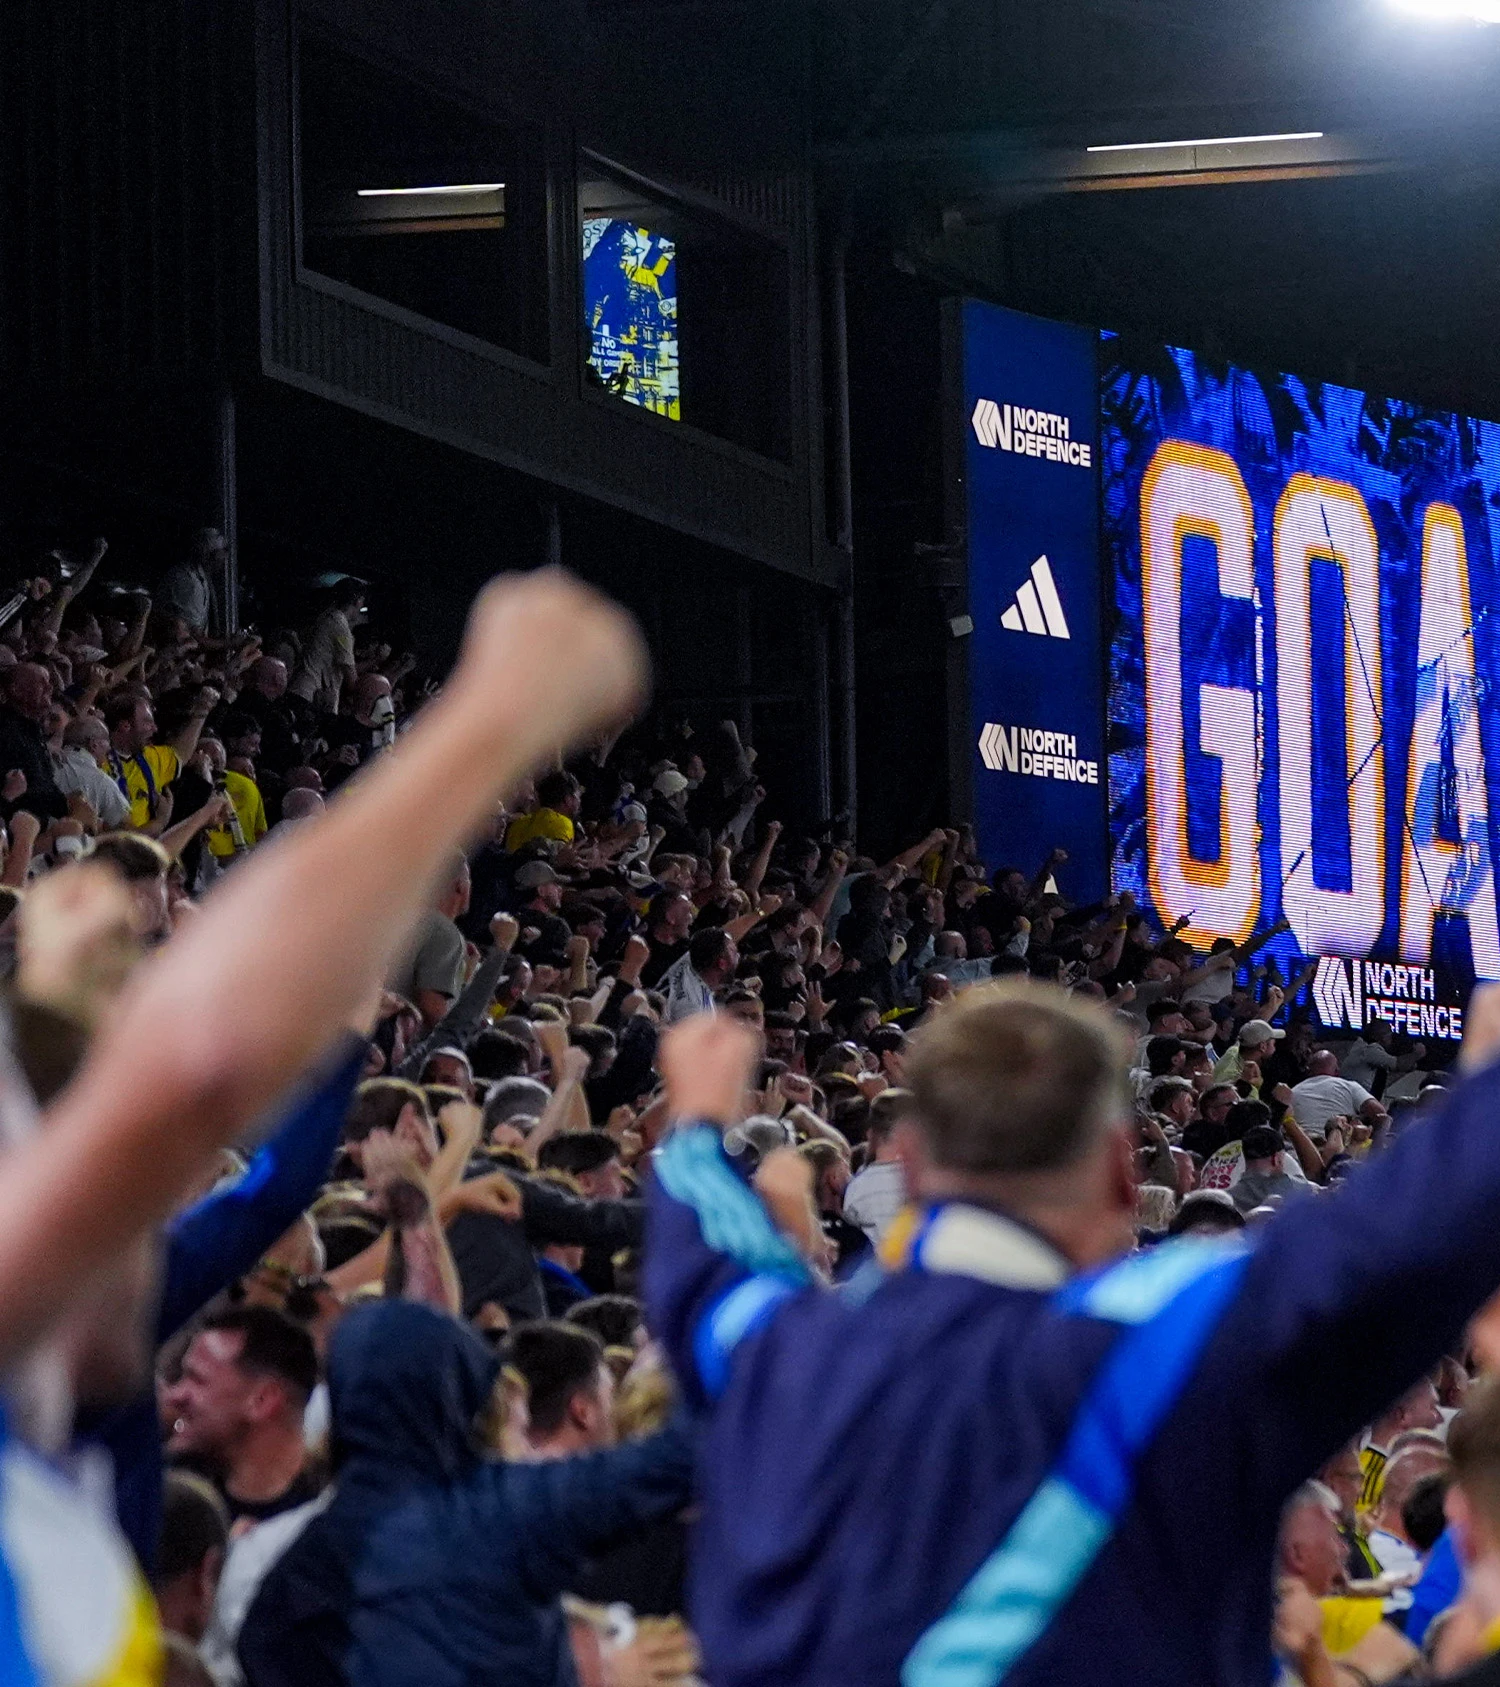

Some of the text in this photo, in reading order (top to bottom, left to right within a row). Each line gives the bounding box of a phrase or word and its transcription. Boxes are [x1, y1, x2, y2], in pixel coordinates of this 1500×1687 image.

[1014, 406, 1069, 439] NORTH
[1014, 430, 1091, 467] DEFENCE
[1021, 728, 1076, 757] NORTH
[1021, 752, 1098, 783] DEFENCE
[1365, 961, 1434, 1000] NORTH
[1366, 999, 1462, 1039] DEFENCE
